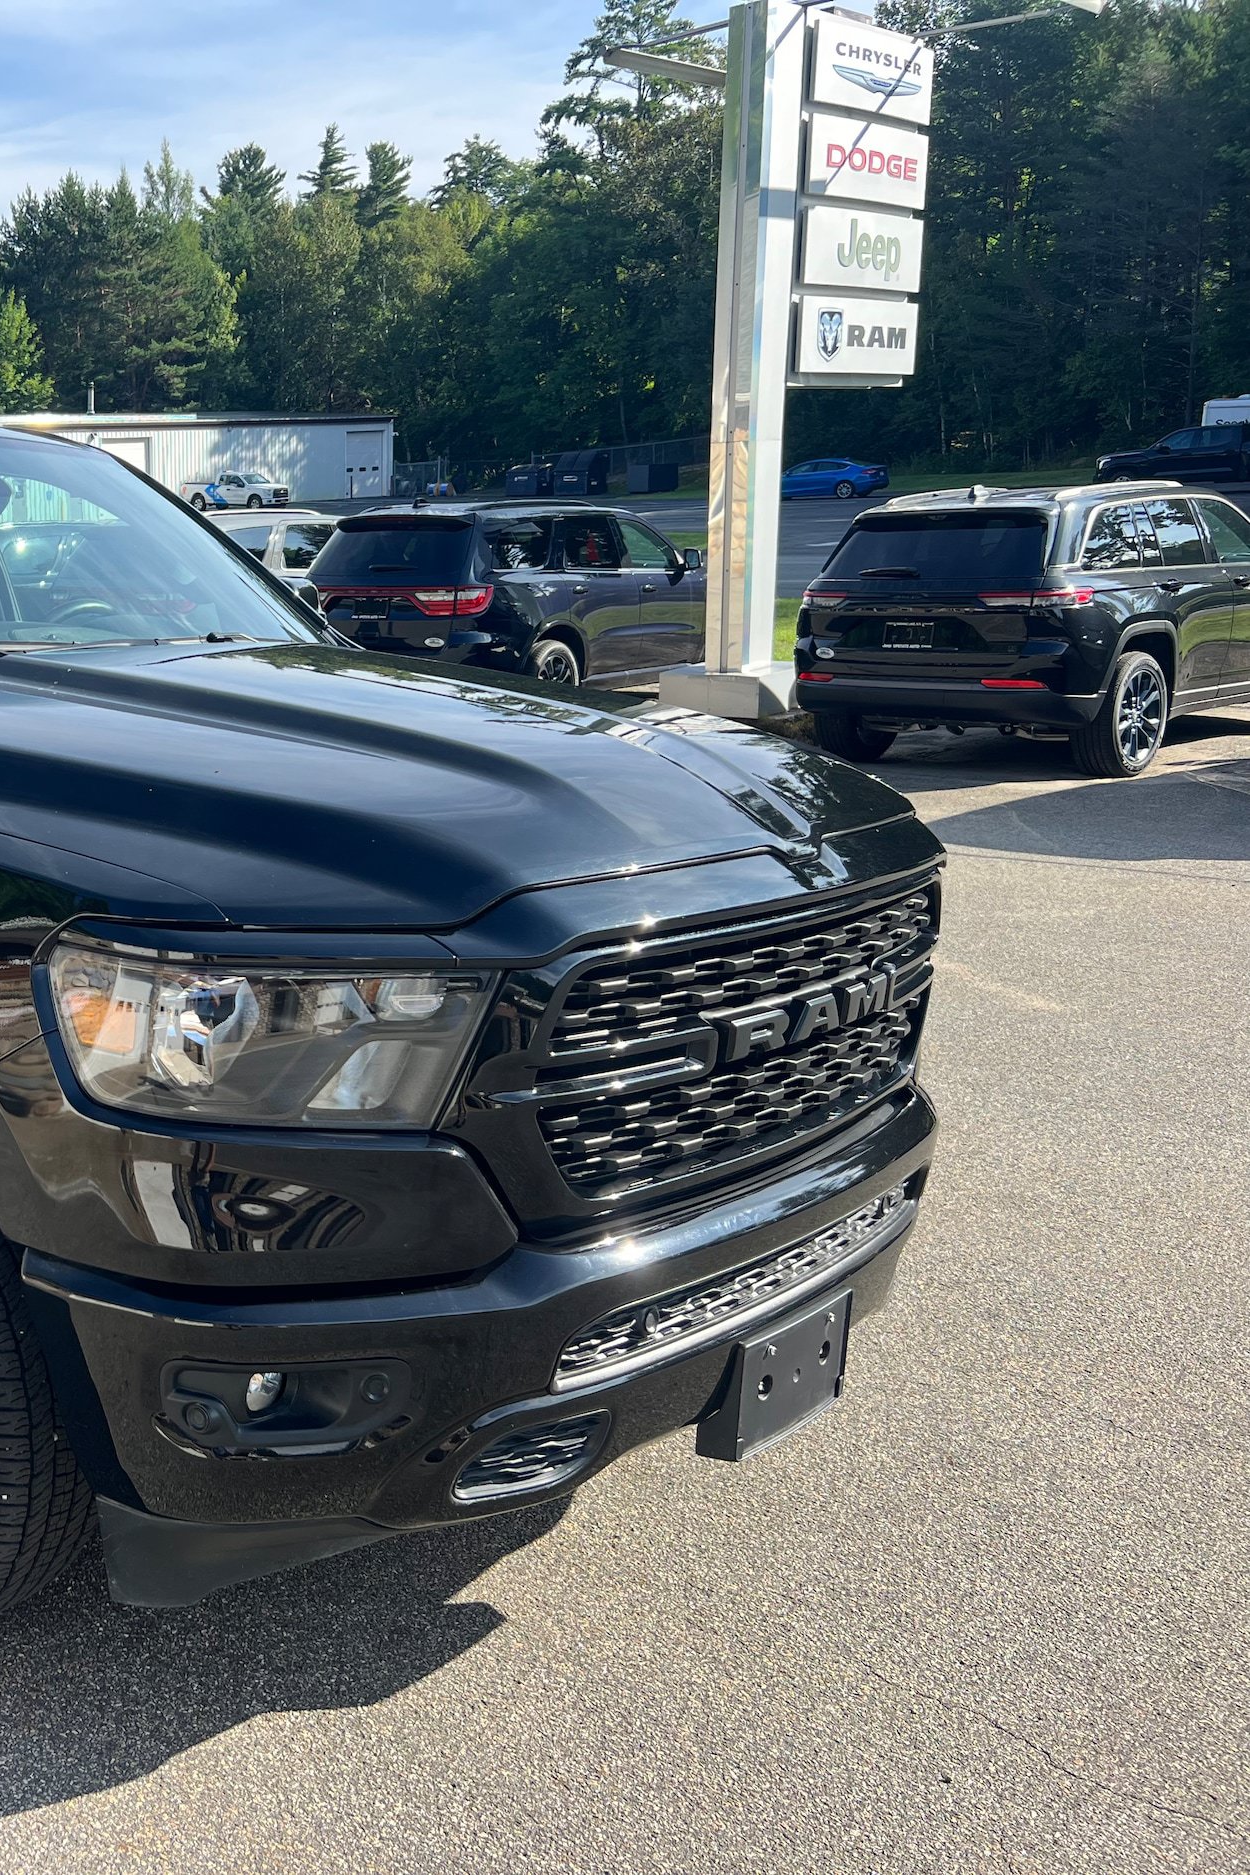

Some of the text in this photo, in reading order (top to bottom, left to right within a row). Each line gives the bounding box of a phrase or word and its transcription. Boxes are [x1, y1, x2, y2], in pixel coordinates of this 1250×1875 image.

[835, 42, 922, 76] CHRYSLER
[826, 144, 918, 182] DODGE
[837, 218, 901, 281] Jeep
[847, 324, 907, 350] RAM
[724, 972, 888, 1063] RAM
